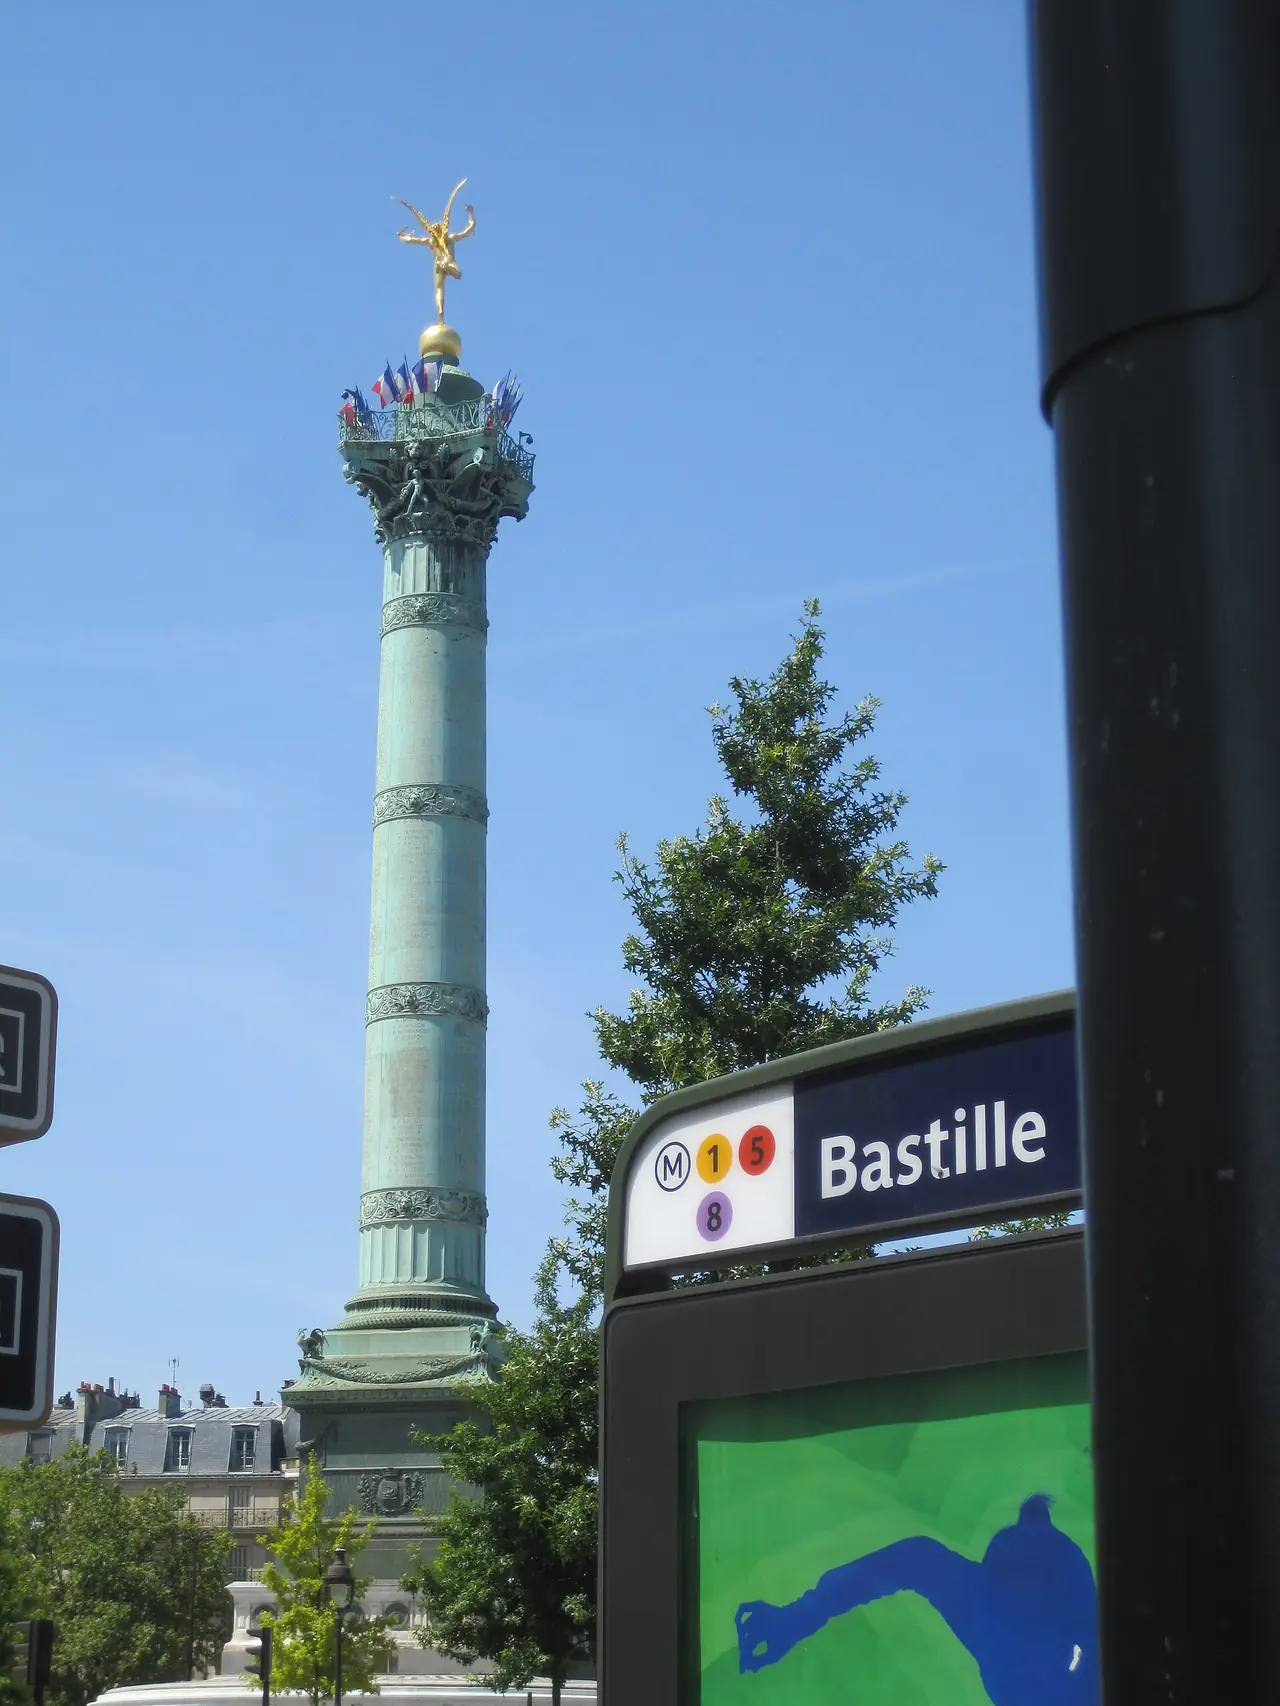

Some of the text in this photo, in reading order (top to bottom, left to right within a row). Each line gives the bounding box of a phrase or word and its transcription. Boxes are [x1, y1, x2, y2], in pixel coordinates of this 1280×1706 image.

[662, 1135, 765, 1182] M 1 5
[821, 1100, 1046, 1199] Bastille
[706, 1201, 722, 1233] 8
